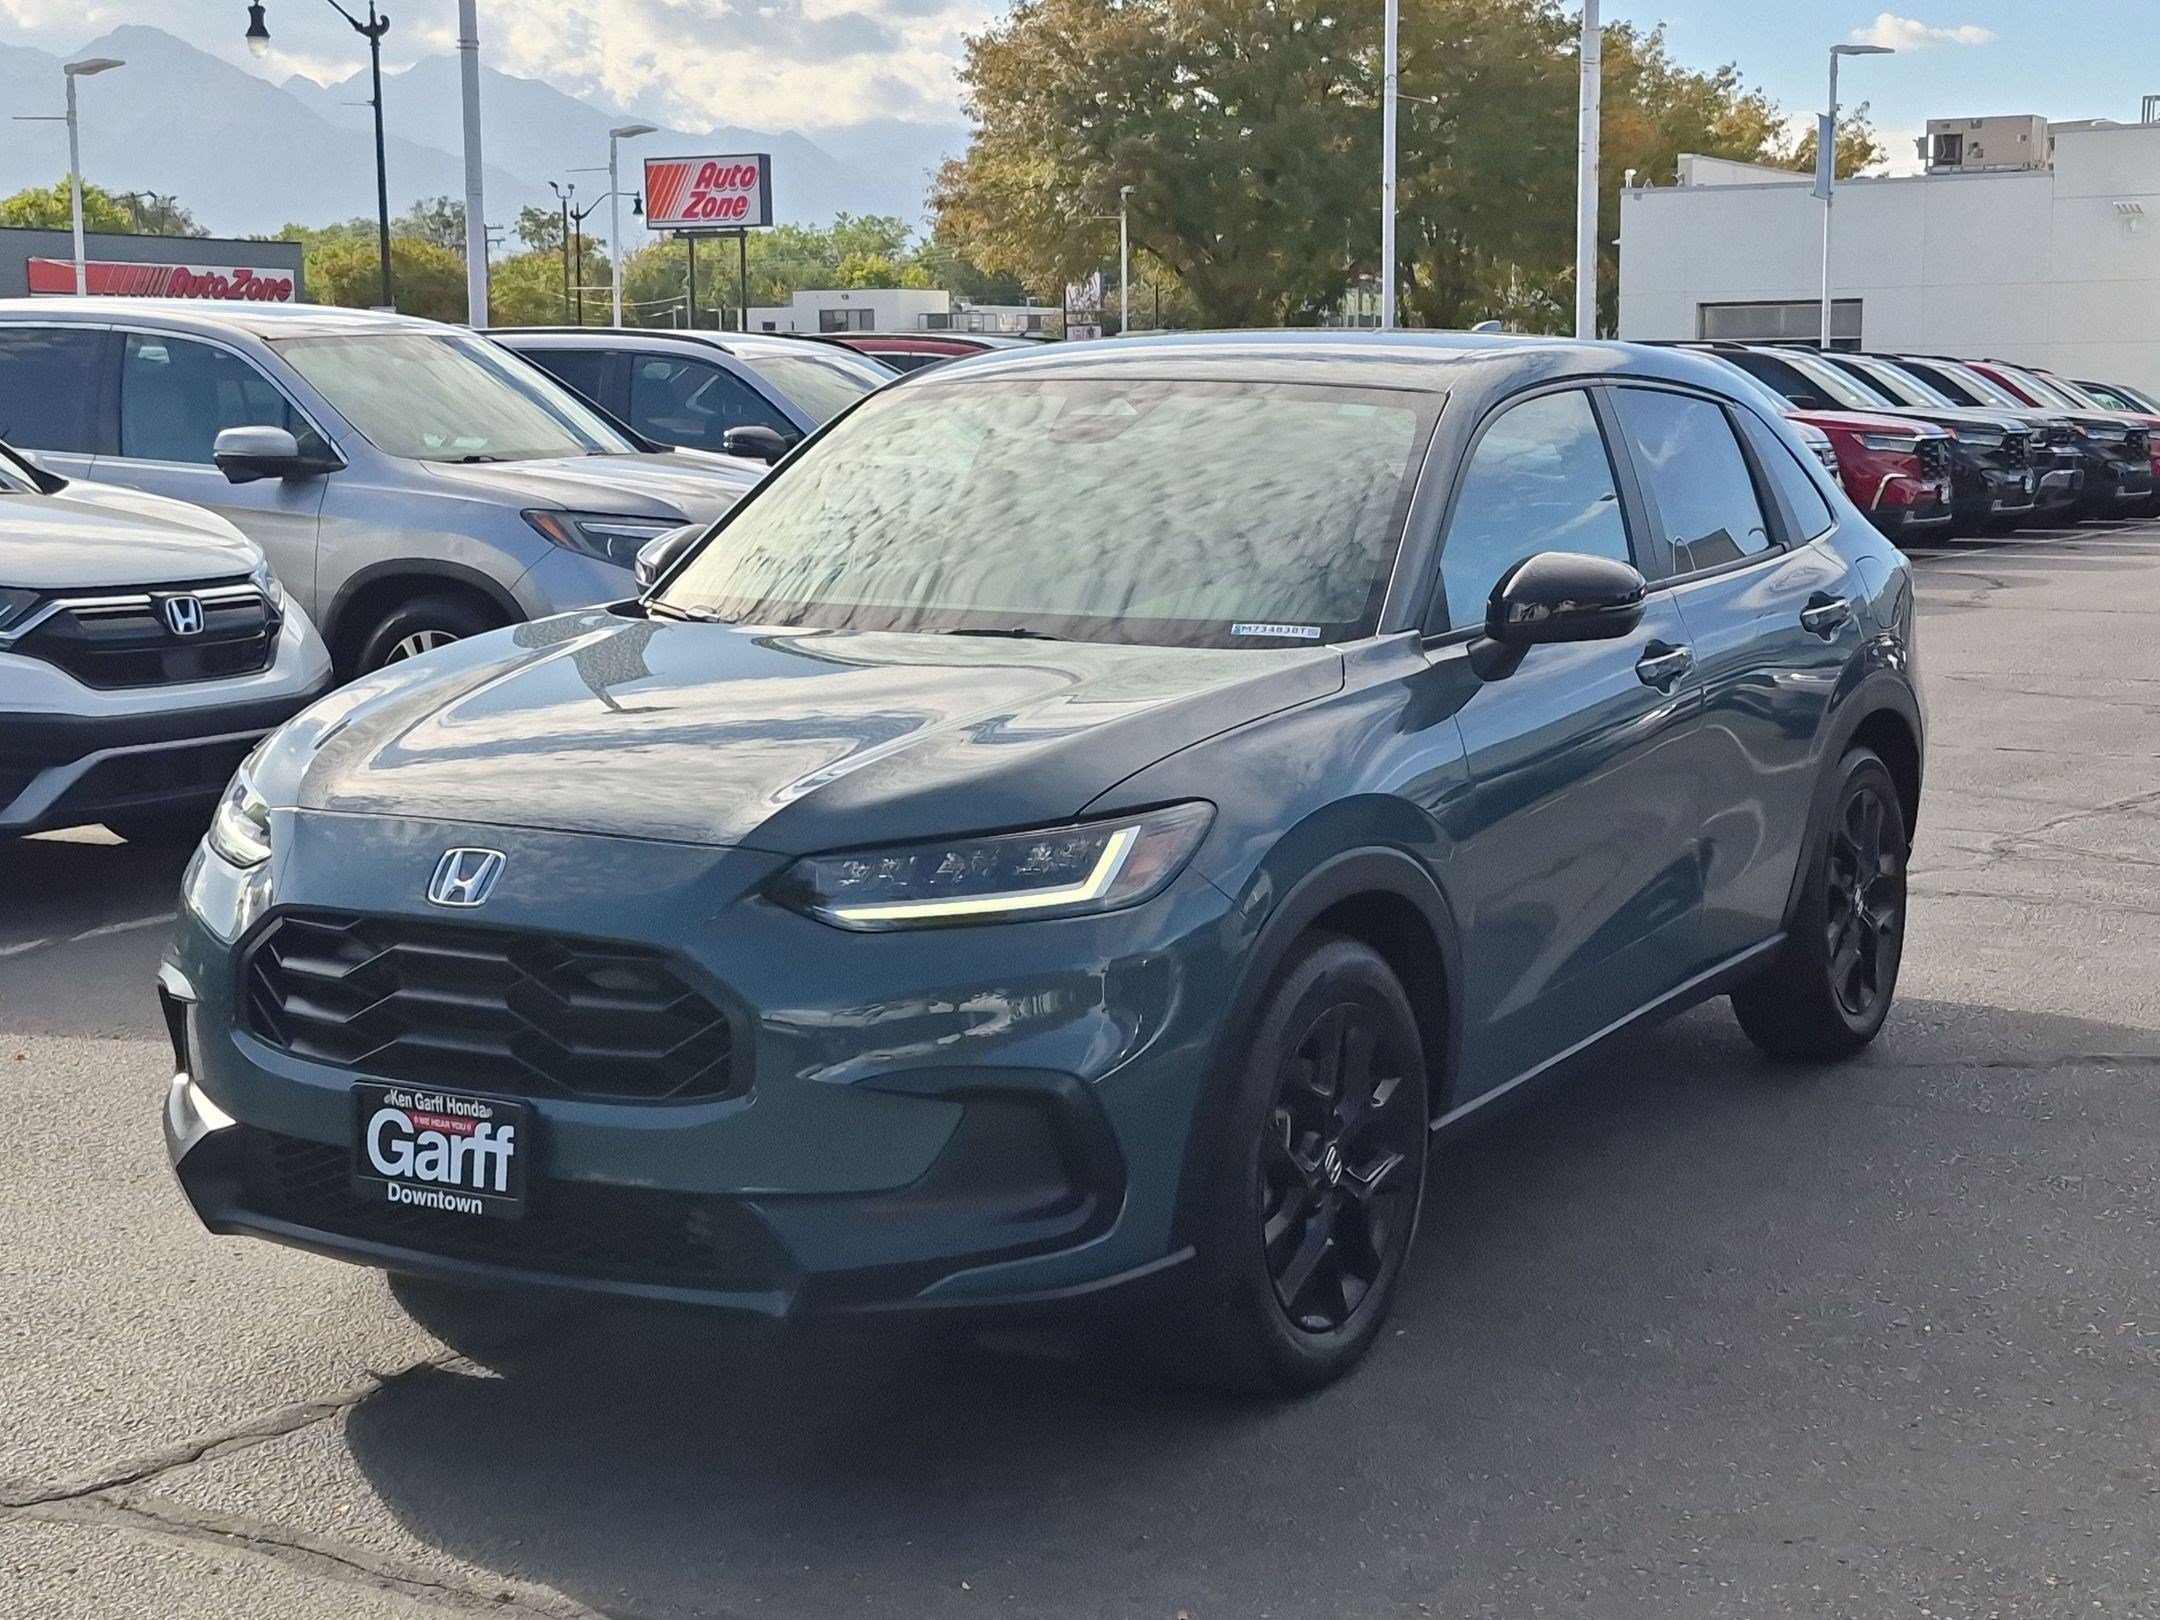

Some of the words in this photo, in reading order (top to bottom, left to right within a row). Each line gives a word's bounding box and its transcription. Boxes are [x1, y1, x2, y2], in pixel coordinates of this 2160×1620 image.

[694, 162, 757, 191] Auto
[681, 191, 749, 220] Zone
[165, 267, 293, 302] AutoZone
[390, 1089, 412, 1109] Ken
[414, 1093, 444, 1113] Garff
[446, 1097, 489, 1118] Honda
[419, 1116, 430, 1126] WE
[431, 1118, 450, 1129] HEAR
[451, 1121, 467, 1131] YOU
[367, 1108, 514, 1192] Garff
[388, 1182, 482, 1215] Downtown
